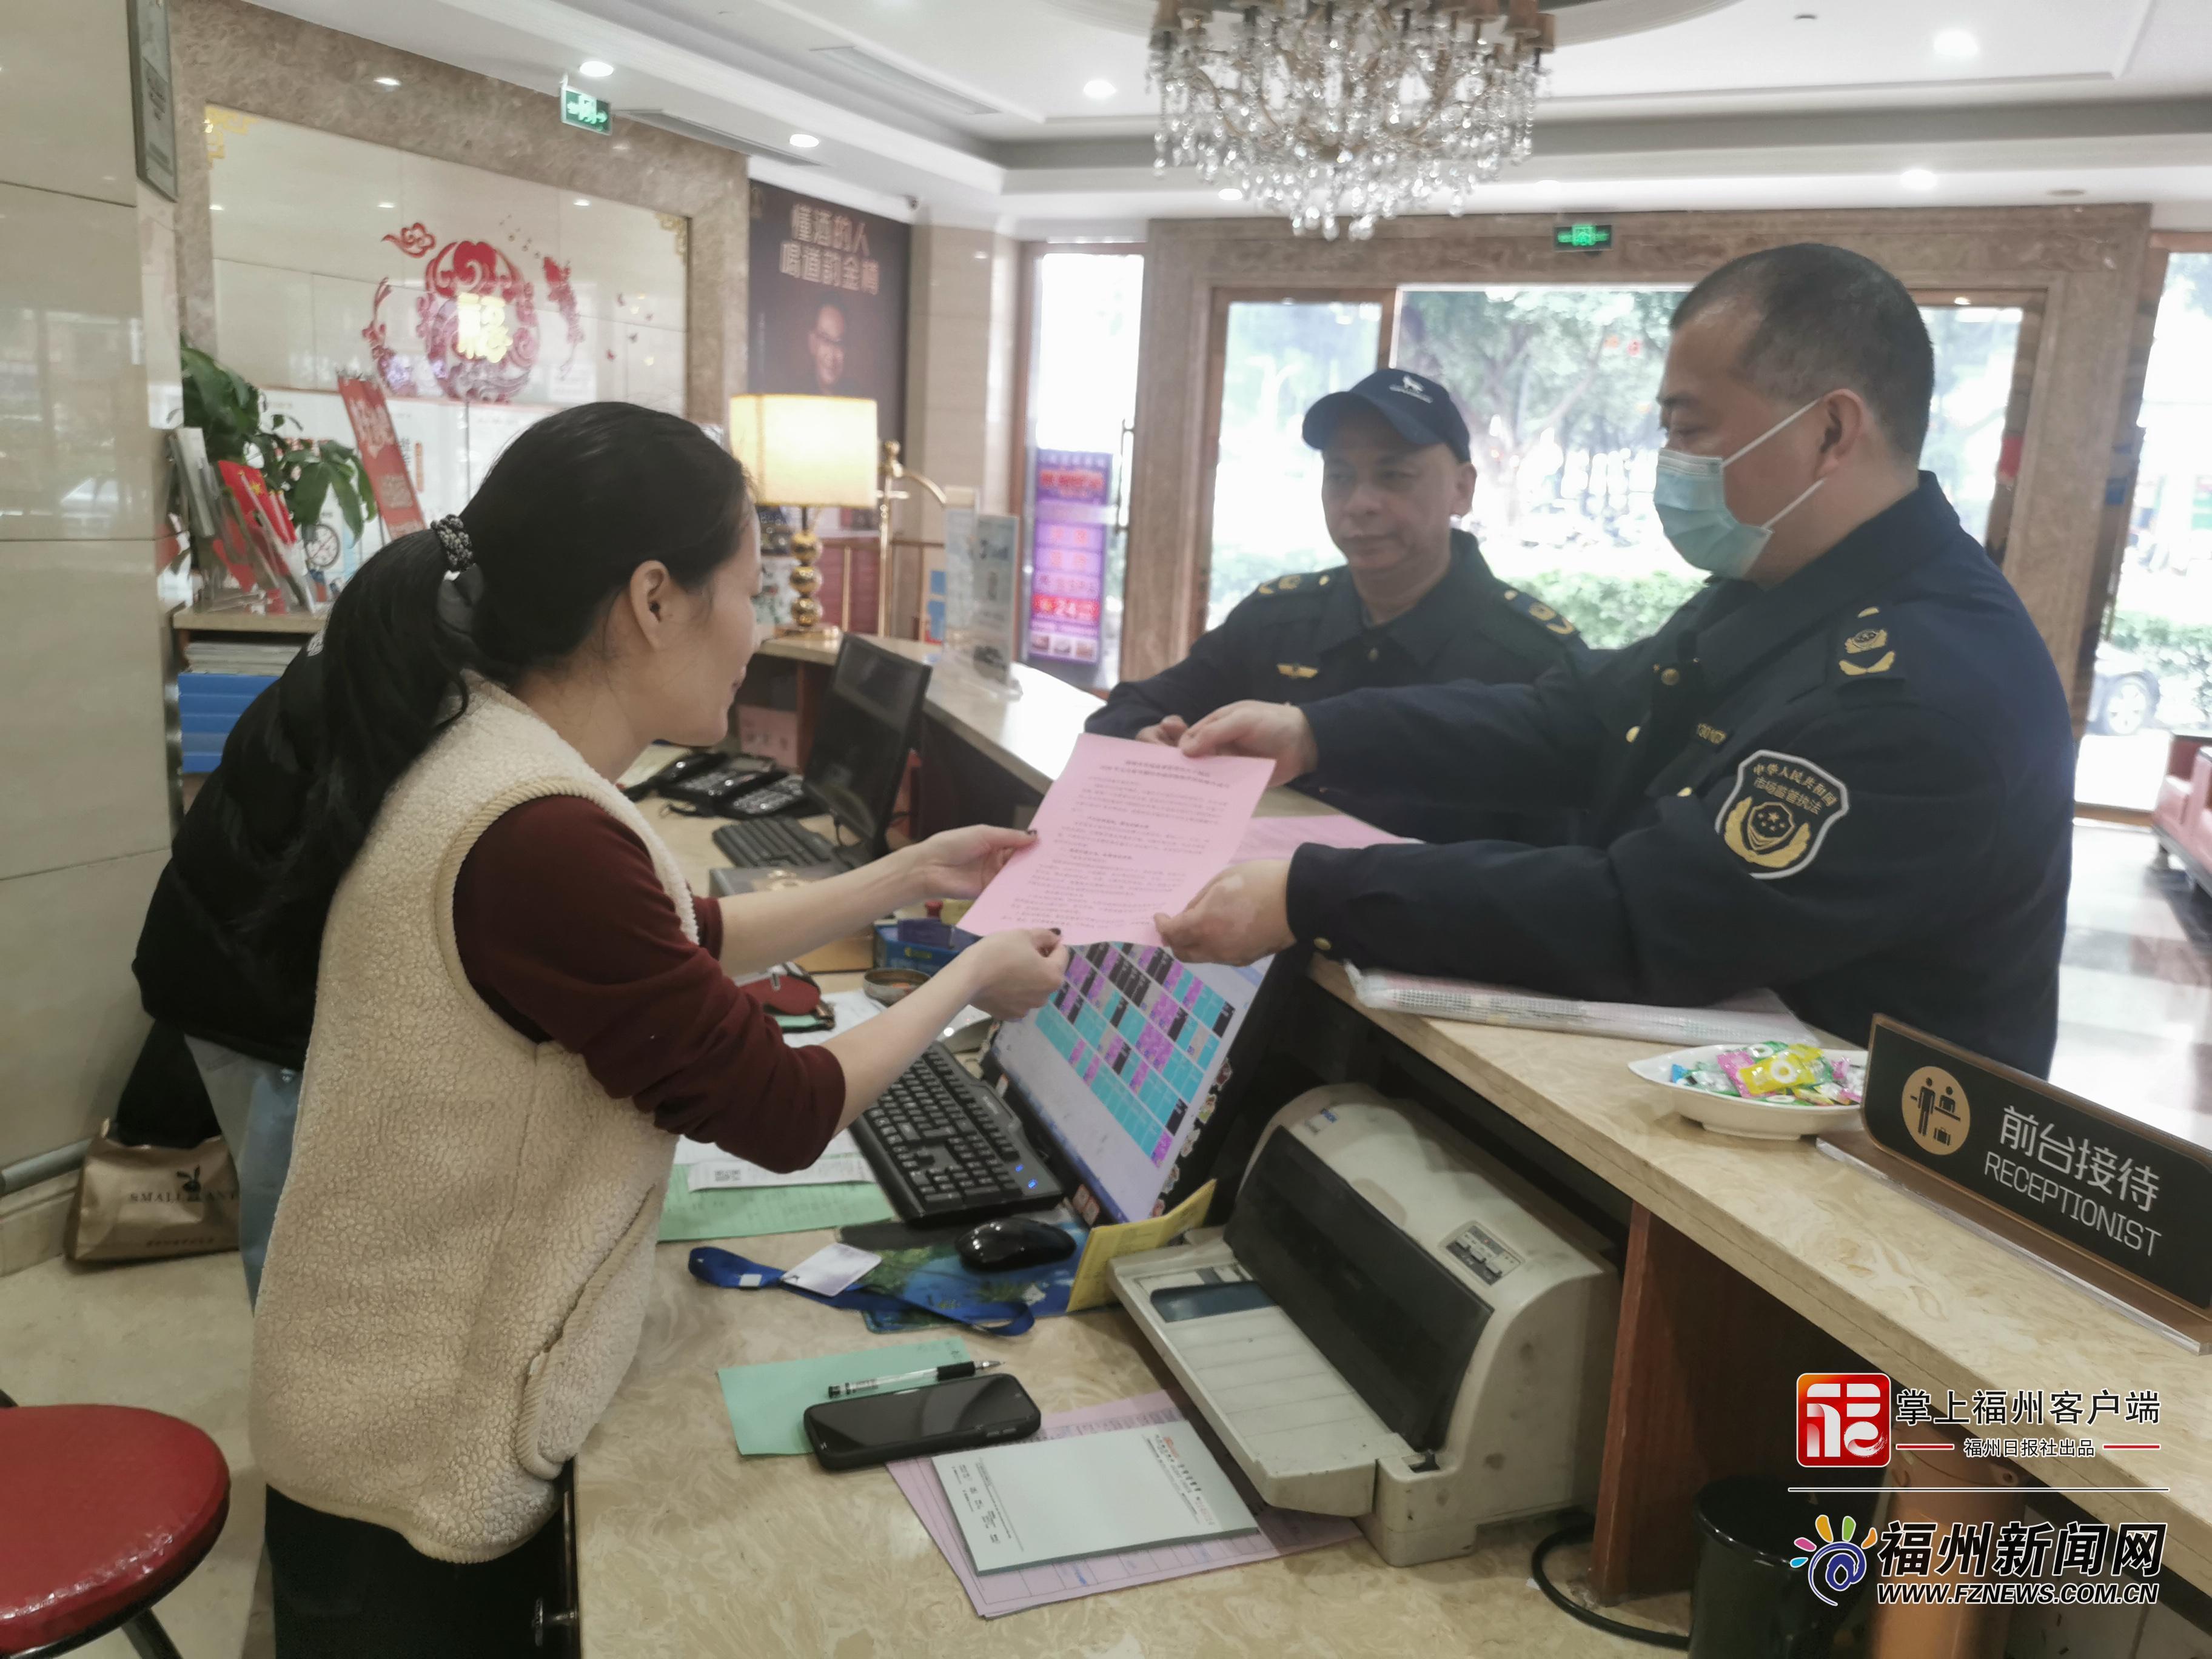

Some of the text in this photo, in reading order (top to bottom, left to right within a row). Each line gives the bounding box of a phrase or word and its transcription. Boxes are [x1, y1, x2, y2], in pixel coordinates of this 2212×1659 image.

[1753, 763, 1838, 807] 中华人民共和国
[1754, 776, 1823, 815] 市场监管执法
[2000, 1105, 2160, 1212] 前台接待
[1985, 1151, 2162, 1256] RECEPTIONIST
